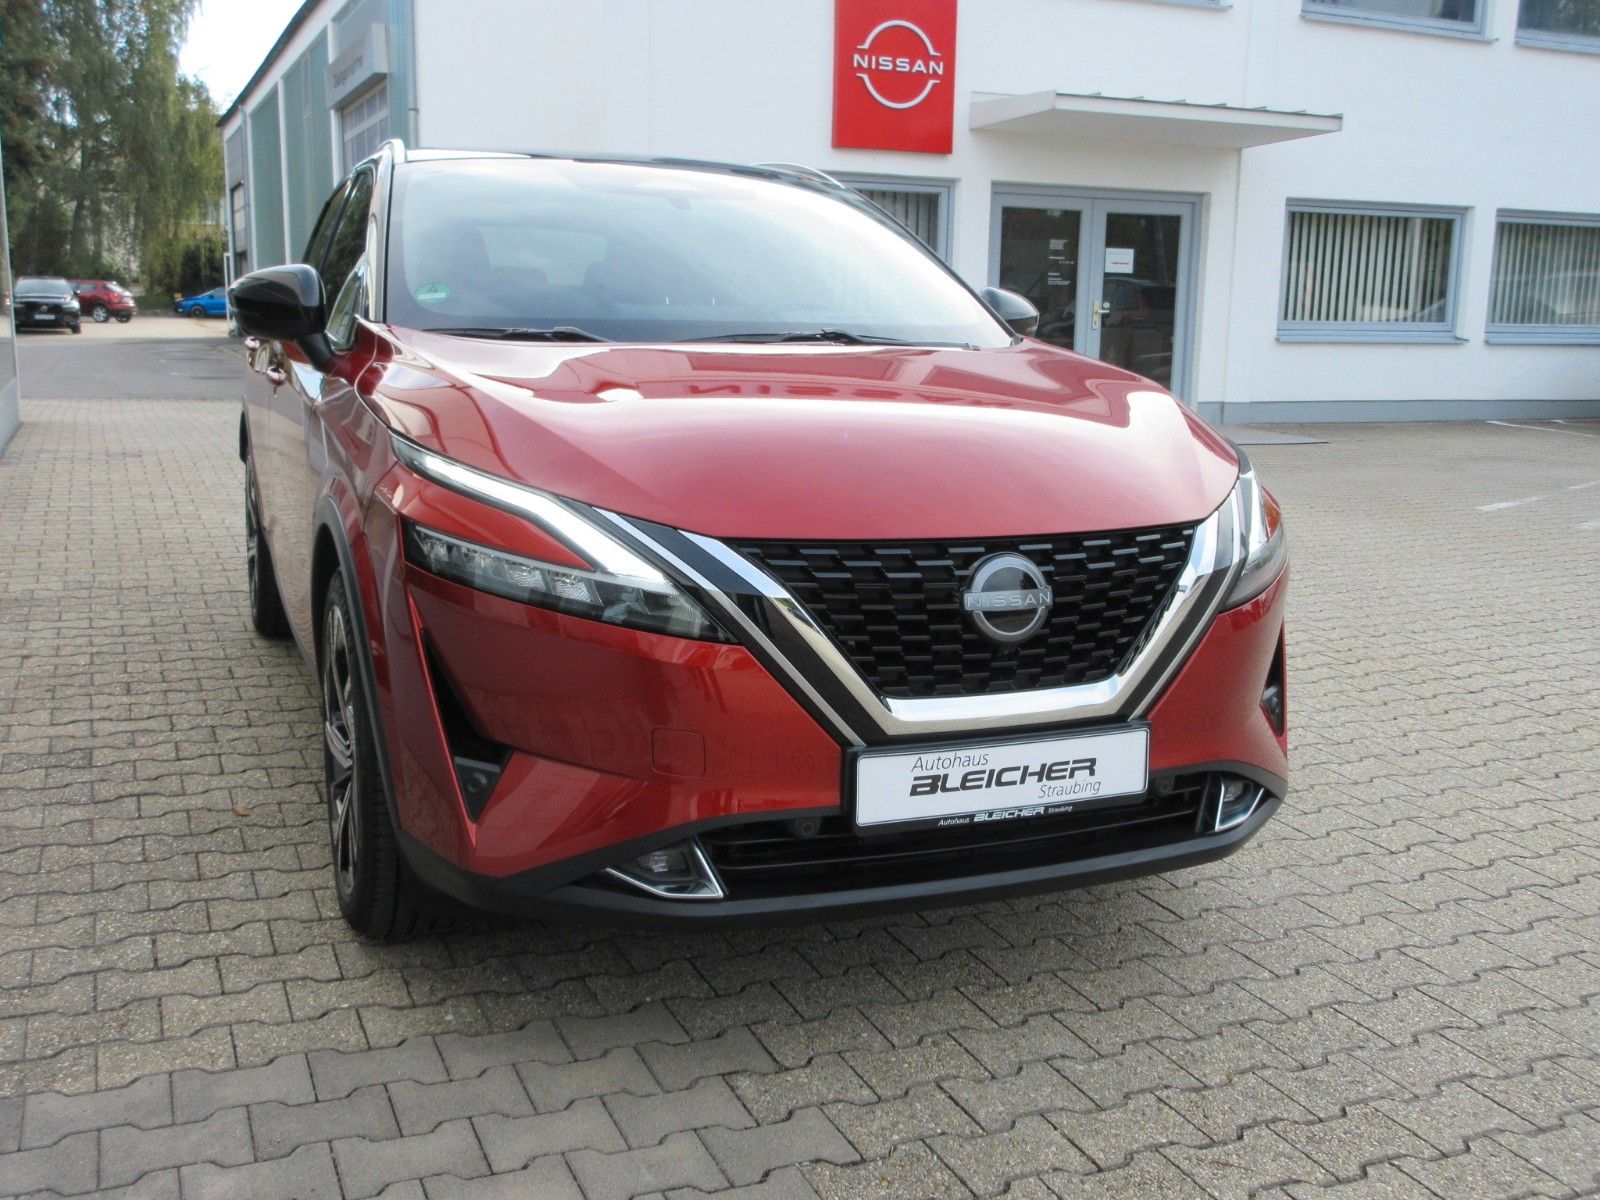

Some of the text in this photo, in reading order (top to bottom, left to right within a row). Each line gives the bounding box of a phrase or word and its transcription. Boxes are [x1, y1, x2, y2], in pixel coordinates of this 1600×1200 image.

[853, 53, 944, 75] NISSAN
[967, 591, 1050, 608] NISSAN
[911, 752, 989, 772] Autohaus
[909, 757, 1097, 797] BLEICHER
[1038, 780, 1101, 798] Straubing
[938, 805, 1073, 827] Autohaus BLEICHER Straubing
